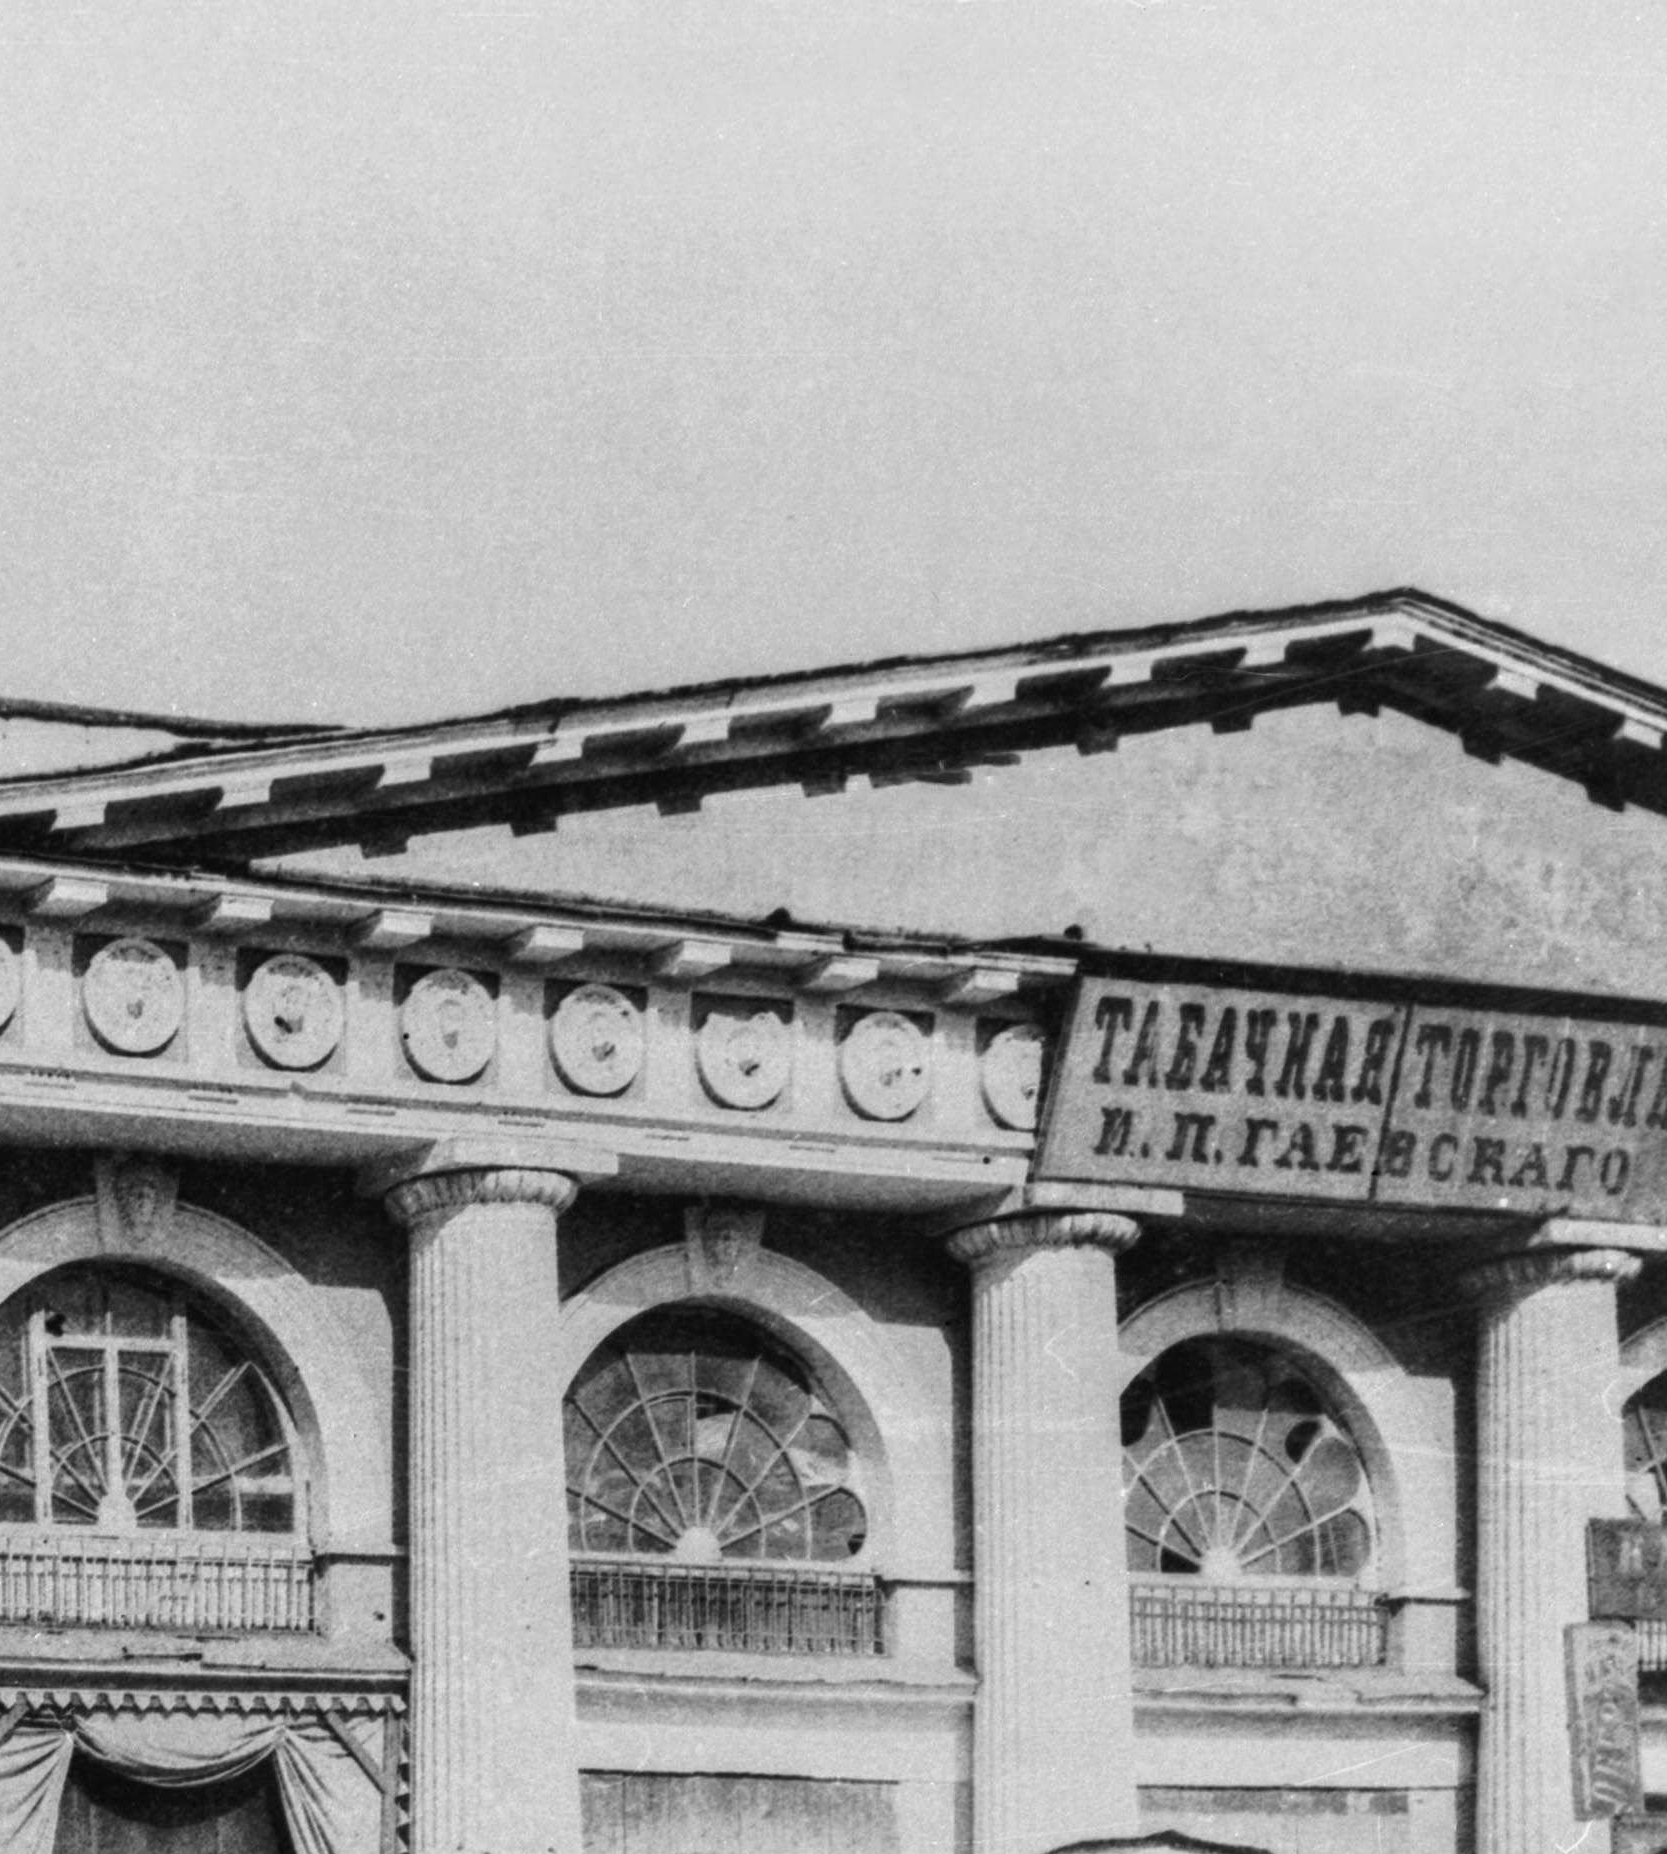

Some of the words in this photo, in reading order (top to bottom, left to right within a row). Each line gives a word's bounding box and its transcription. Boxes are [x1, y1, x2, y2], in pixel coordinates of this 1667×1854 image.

[1093, 996, 1397, 1105] ТАБАЧНАЯ
[1414, 1023, 1667, 1131] ТОРГОВЛ
[1164, 1111, 1224, 1164] П.
[1237, 1115, 1632, 1196] ГАЕВСКАГО
